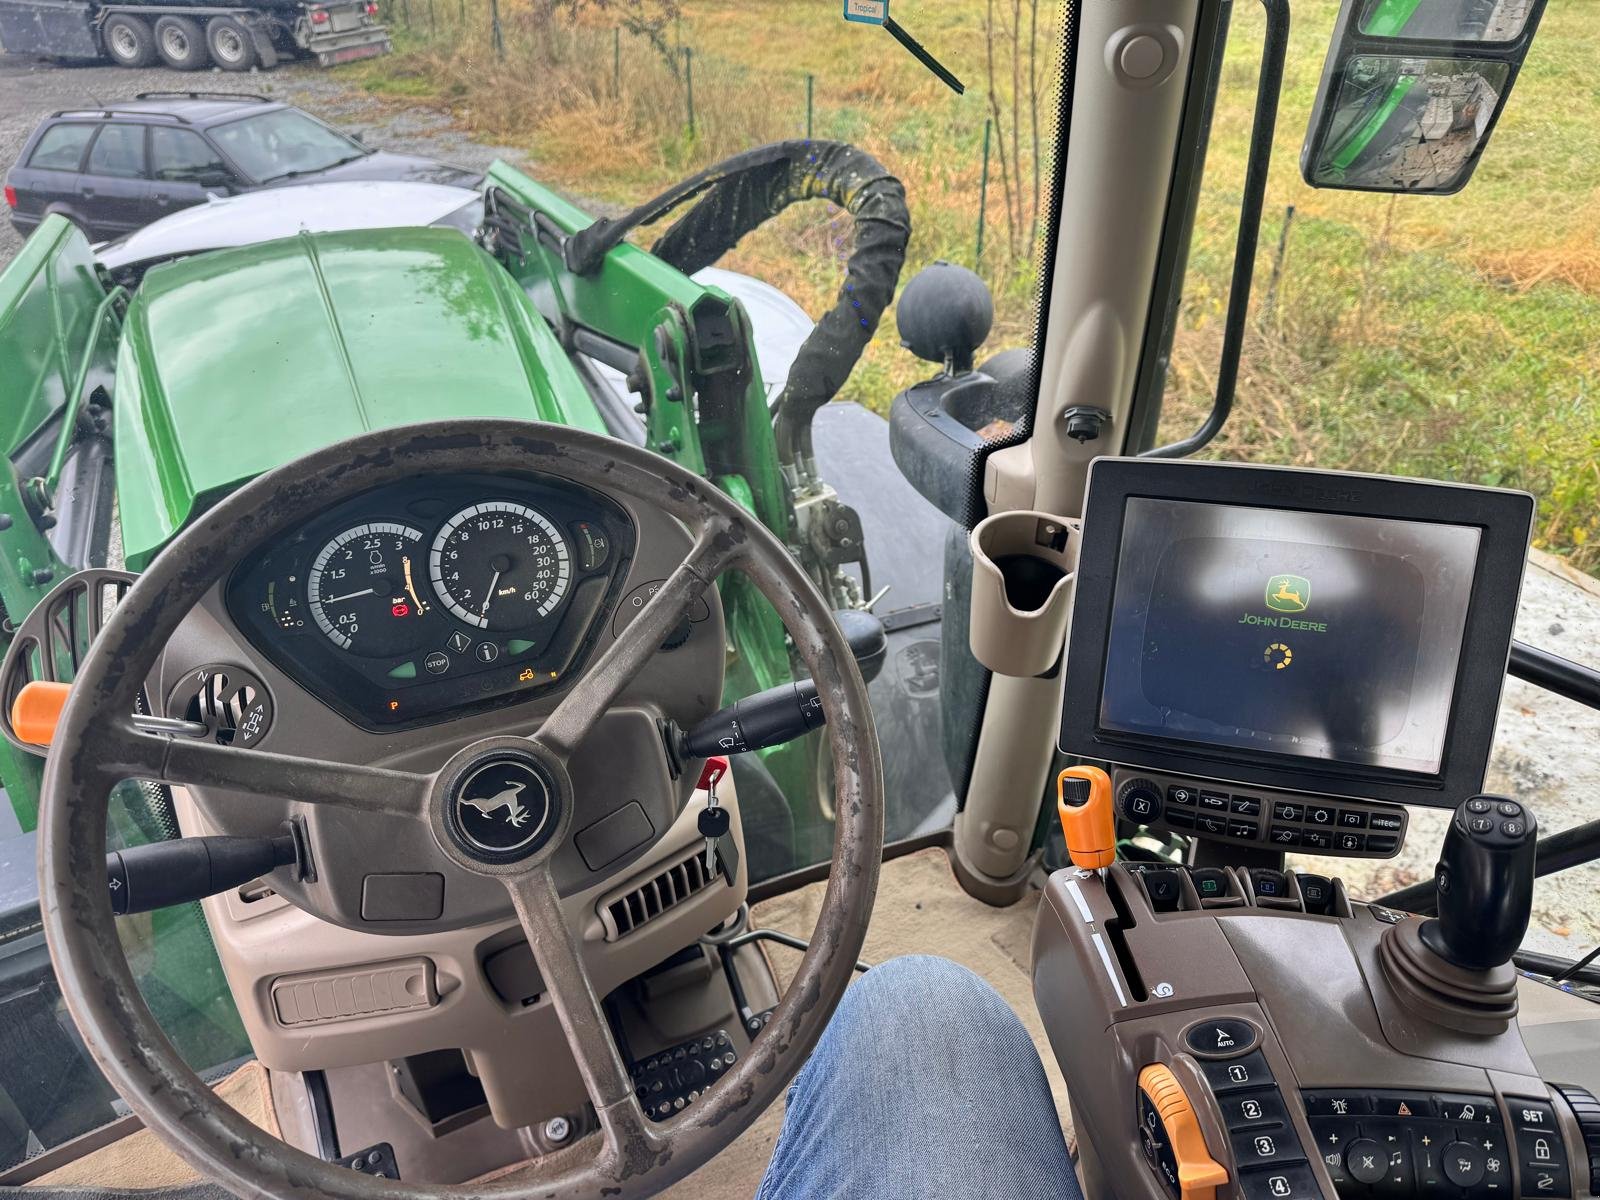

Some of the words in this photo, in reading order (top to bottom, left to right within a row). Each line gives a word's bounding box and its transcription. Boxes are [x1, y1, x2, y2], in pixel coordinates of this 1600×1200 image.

[855, 2, 877, 14] Tropical
[478, 521, 490, 531] 10
[491, 519, 504, 528] 12
[511, 524, 523, 534] 15
[461, 532, 469, 541] 8
[527, 535, 539, 544] 18
[364, 539, 381, 549] 2.5
[395, 542, 402, 550] 3
[345, 551, 353, 559] 2
[450, 550, 458, 559] 6
[532, 545, 546, 555] 20
[536, 557, 551, 567] 30
[331, 569, 345, 579] 1.5
[451, 571, 459, 580] 4
[536, 569, 550, 579] 40
[532, 580, 546, 590] 50
[464, 589, 472, 598] 2
[498, 586, 516, 596] km/h
[524, 591, 539, 601] 60
[339, 613, 357, 624] 0.5
[1238, 612, 1278, 627] JOHN
[1279, 616, 1329, 633] DEERE
[351, 624, 358, 633] 0
[427, 658, 446, 668] STOP
[197, 671, 208, 682] N
[391, 701, 398, 710] P
[1475, 802, 1482, 810] 5
[1505, 804, 1512, 812] 6
[1478, 820, 1484, 828] 7
[1509, 824, 1515, 832] 8
[1217, 1039, 1234, 1047] AUTO
[1234, 1069, 1242, 1080] 1
[1247, 1104, 1256, 1115] 2
[1485, 1115, 1490, 1123] 2
[1522, 1109, 1543, 1123] SET
[1260, 1140, 1269, 1153] 3
[1162, 1161, 1175, 1184] ECO
[1275, 1181, 1285, 1193] 4
